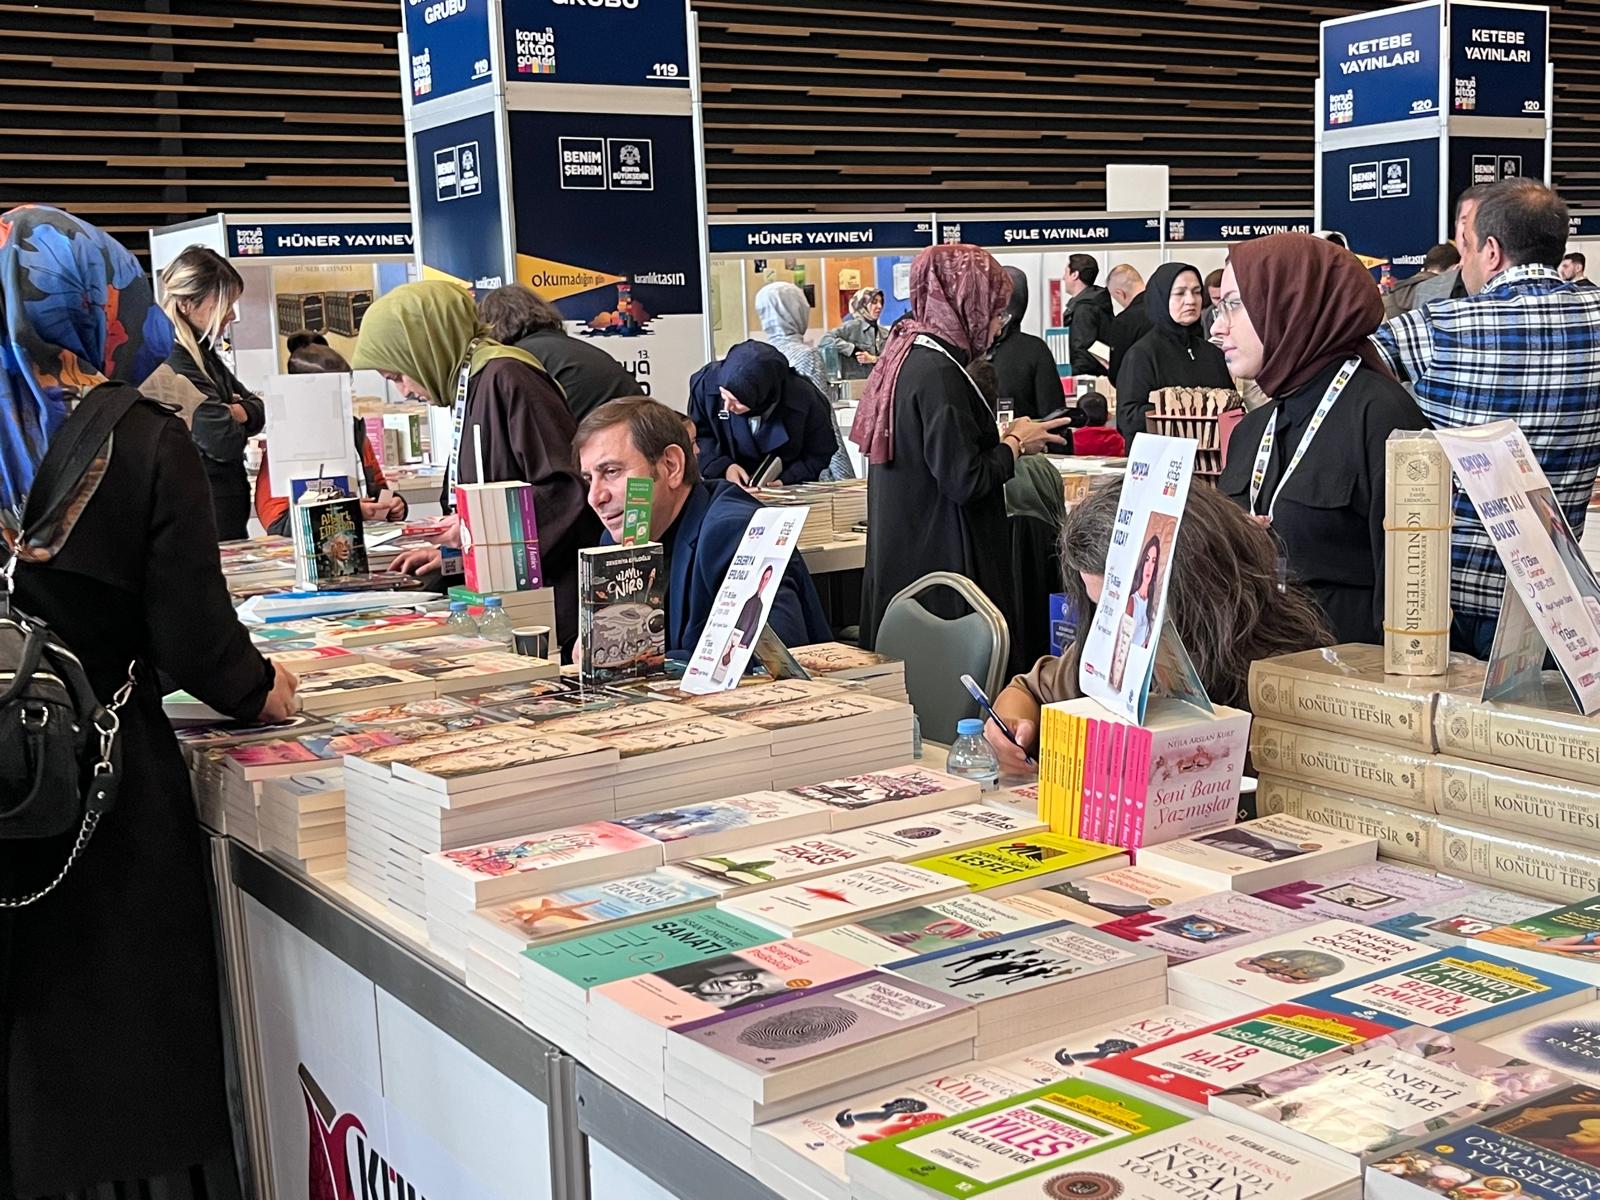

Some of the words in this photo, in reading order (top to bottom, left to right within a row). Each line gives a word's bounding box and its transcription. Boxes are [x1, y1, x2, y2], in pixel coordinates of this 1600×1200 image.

[424, 0, 467, 24] GRUBU
[516, 28, 555, 44] konya
[1348, 33, 1413, 57] KETEBE
[1472, 29, 1526, 46] KETEBE
[516, 41, 556, 57] kitap
[1465, 46, 1531, 63] YAYINLARI
[474, 59, 490, 75] 119
[653, 63, 679, 77] 119
[1339, 50, 1420, 75] YAYINLARI
[1411, 99, 1432, 111] 120
[1523, 100, 1540, 111] 120
[277, 233, 341, 248] HÜNER
[343, 233, 414, 247] YAYINEV
[747, 230, 803, 246] HÜNER
[806, 228, 874, 244] YAYINEVİ
[1004, 228, 1039, 242] ŞULE
[1042, 226, 1109, 240] YAYINLARI
[1220, 225, 1252, 238] ŞULE
[1253, 224, 1310, 235] YAYINLARI
[531, 270, 593, 289] okumadığın
[1478, 496, 1514, 520] MEHMET
[1491, 519, 1521, 542] BULUT
[1405, 581, 1420, 632] TEFSİR
[1298, 696, 1348, 718] KONULU
[1350, 706, 1395, 728] TEFSİR
[1188, 735, 1215, 746] ARSLAN
[1495, 730, 1556, 755] KONULU
[1558, 741, 1600, 766] TEFSİ
[1300, 752, 1349, 775] KONULU
[1351, 763, 1398, 787] TEFSİR
[1154, 783, 1187, 807] Seni
[1190, 777, 1232, 799] Bana
[1153, 794, 1235, 829] Yazmışlar
[1494, 795, 1554, 819] KONULU
[1558, 806, 1600, 829] TEFSİ
[1305, 808, 1354, 831] KONULU
[1356, 818, 1402, 844] TEFSİR
[1495, 856, 1556, 881] KONULU
[651, 921, 727, 955] SANATI
[1311, 935, 1392, 964] ÇOCUKLAR
[1333, 933, 1403, 957] İÇİNDEKİ
[1347, 927, 1417, 953] FANUSUN
[1411, 971, 1433, 982] 40
[1438, 976, 1505, 1004] YILLIK
[1431, 963, 1448, 974] 7
[1448, 967, 1521, 997] ADIMDA
[1362, 983, 1469, 1018] TEMİZLİĞİ
[1398, 980, 1473, 1005] BEDEN
[1263, 1026, 1317, 1043] HIZLI
[1181, 1049, 1245, 1073] HATA
[1224, 1044, 1260, 1059] 18
[1357, 1059, 1463, 1101] MANEVİ
[1006, 1108, 1099, 1145] BESLENEREK
[948, 1127, 984, 1146] KALICI
[1007, 1151, 1036, 1165] VER
[1464, 1136, 1600, 1194] OSMANLI'N
